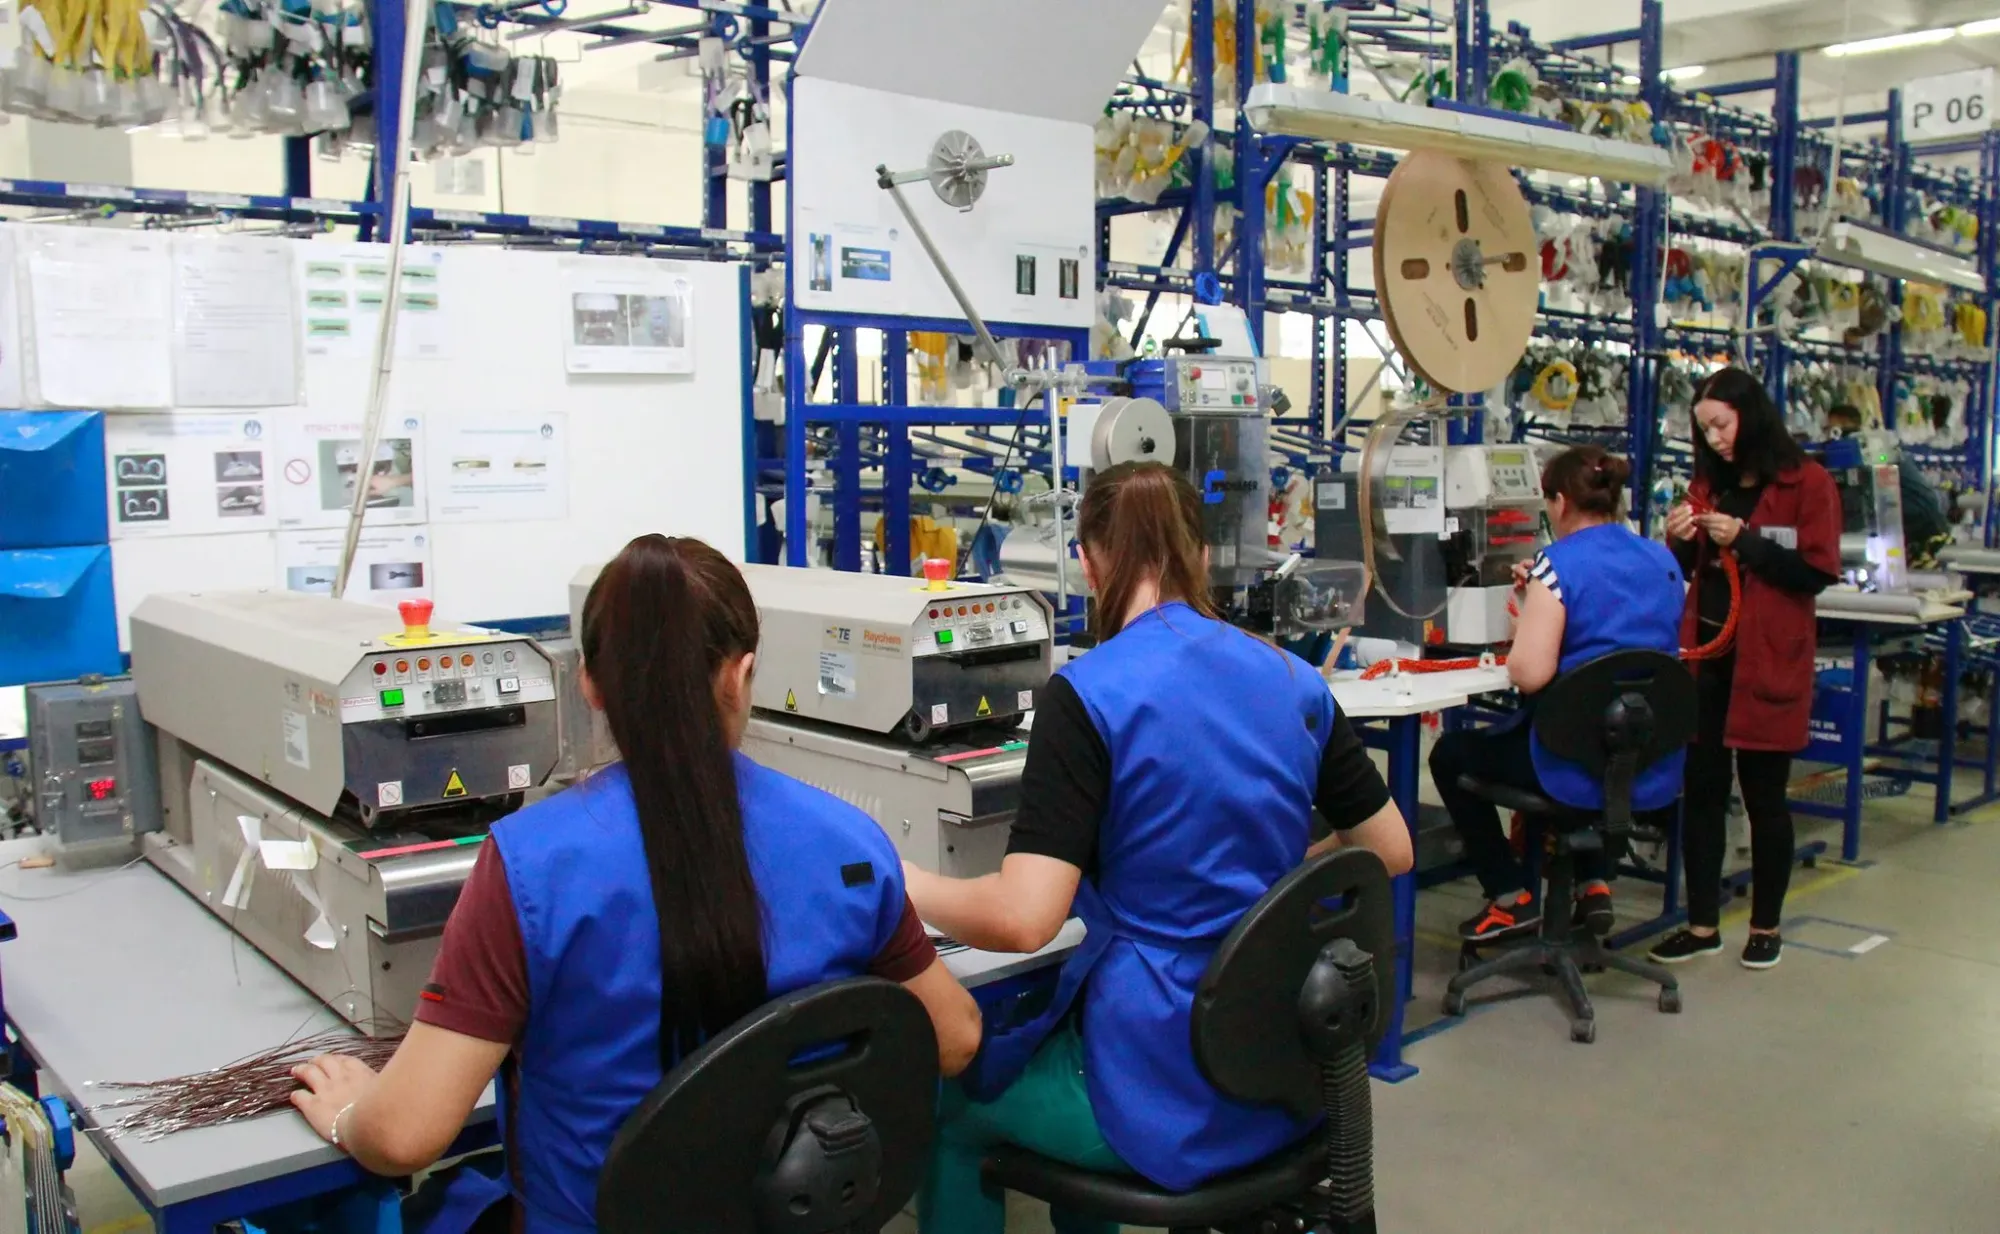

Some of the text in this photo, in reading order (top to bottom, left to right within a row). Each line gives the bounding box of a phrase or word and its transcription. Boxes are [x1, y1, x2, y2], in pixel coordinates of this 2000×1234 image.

[1913, 94, 1984, 129] P 06
[838, 627, 851, 641] TE
[863, 629, 902, 645] Raychem
